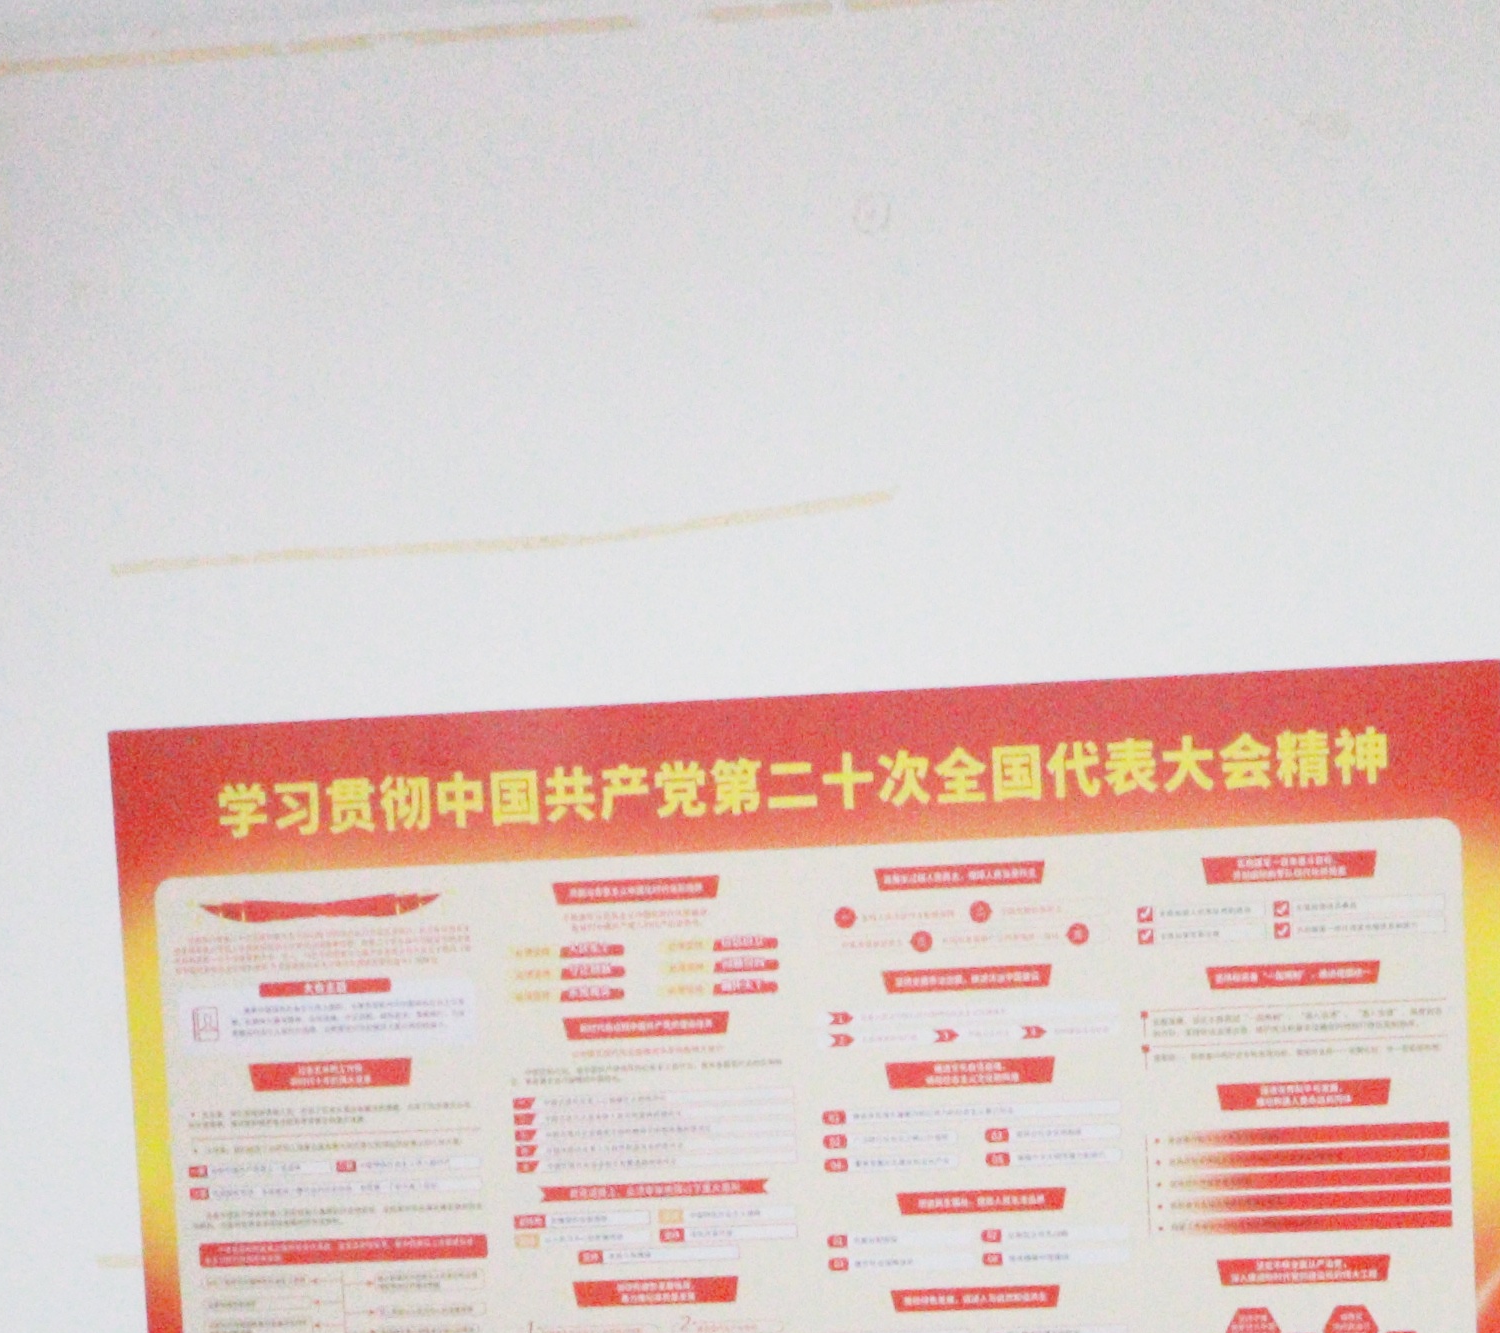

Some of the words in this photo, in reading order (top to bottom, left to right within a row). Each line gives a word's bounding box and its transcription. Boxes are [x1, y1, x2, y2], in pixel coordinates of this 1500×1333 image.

[217, 727, 1389, 838] 学习贯彻中国共产党第二十次全国代表大会精神
